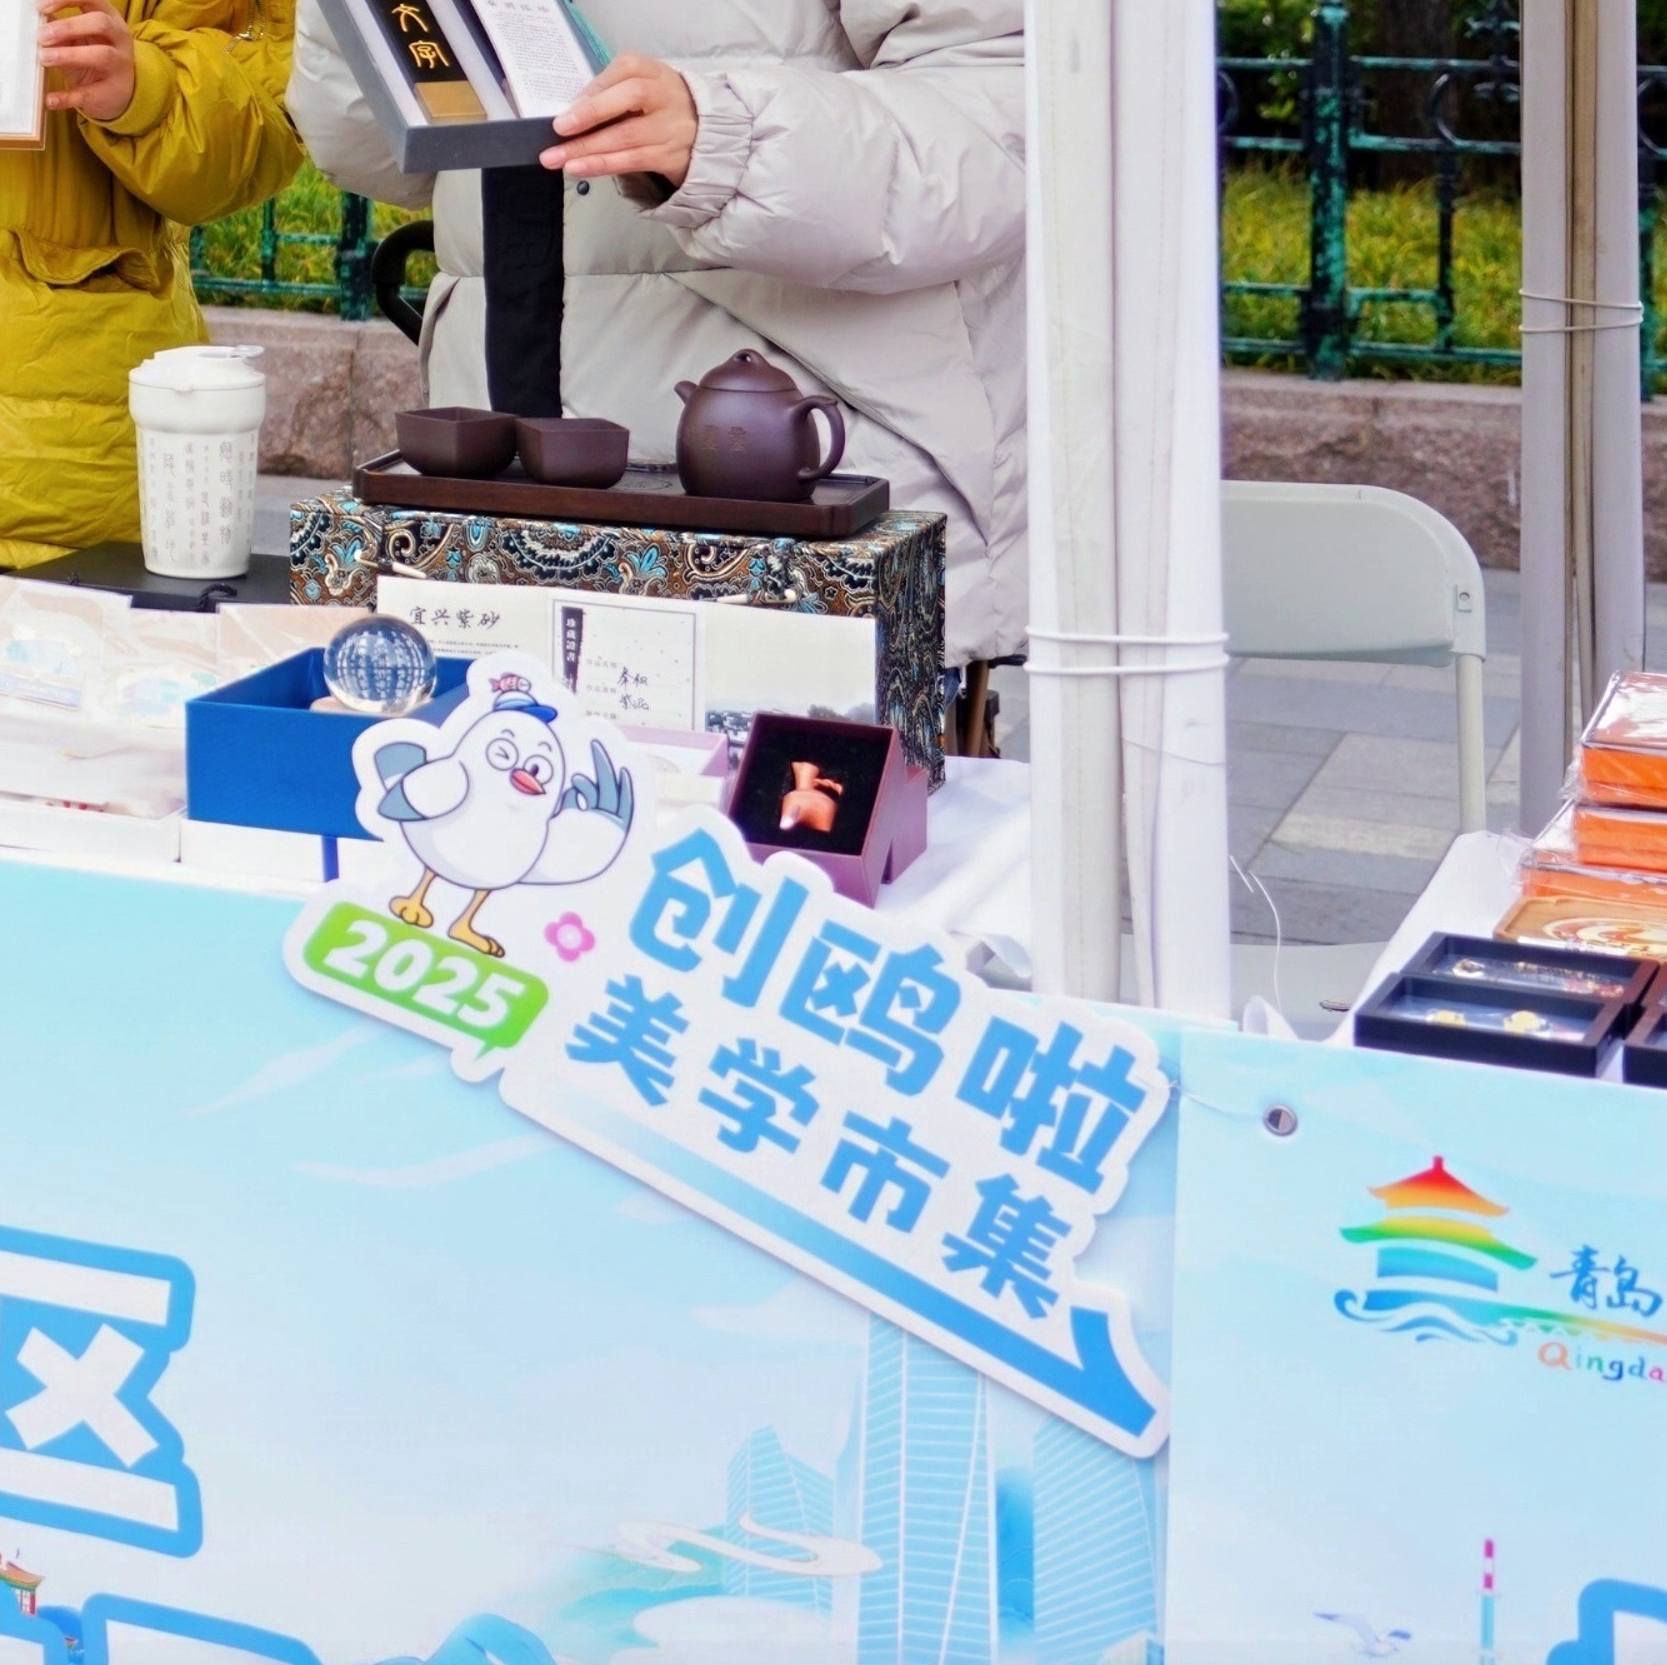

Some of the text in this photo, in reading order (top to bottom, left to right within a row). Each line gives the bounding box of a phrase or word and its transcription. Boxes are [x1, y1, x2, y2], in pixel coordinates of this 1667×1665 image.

[409, 605, 501, 630] 宜兴紫砂
[322, 918, 525, 1030] 2025
[628, 828, 1147, 1196] 创鸥啦
[566, 974, 1074, 1320] 美学市集
[1549, 1245, 1663, 1318] 青岛
